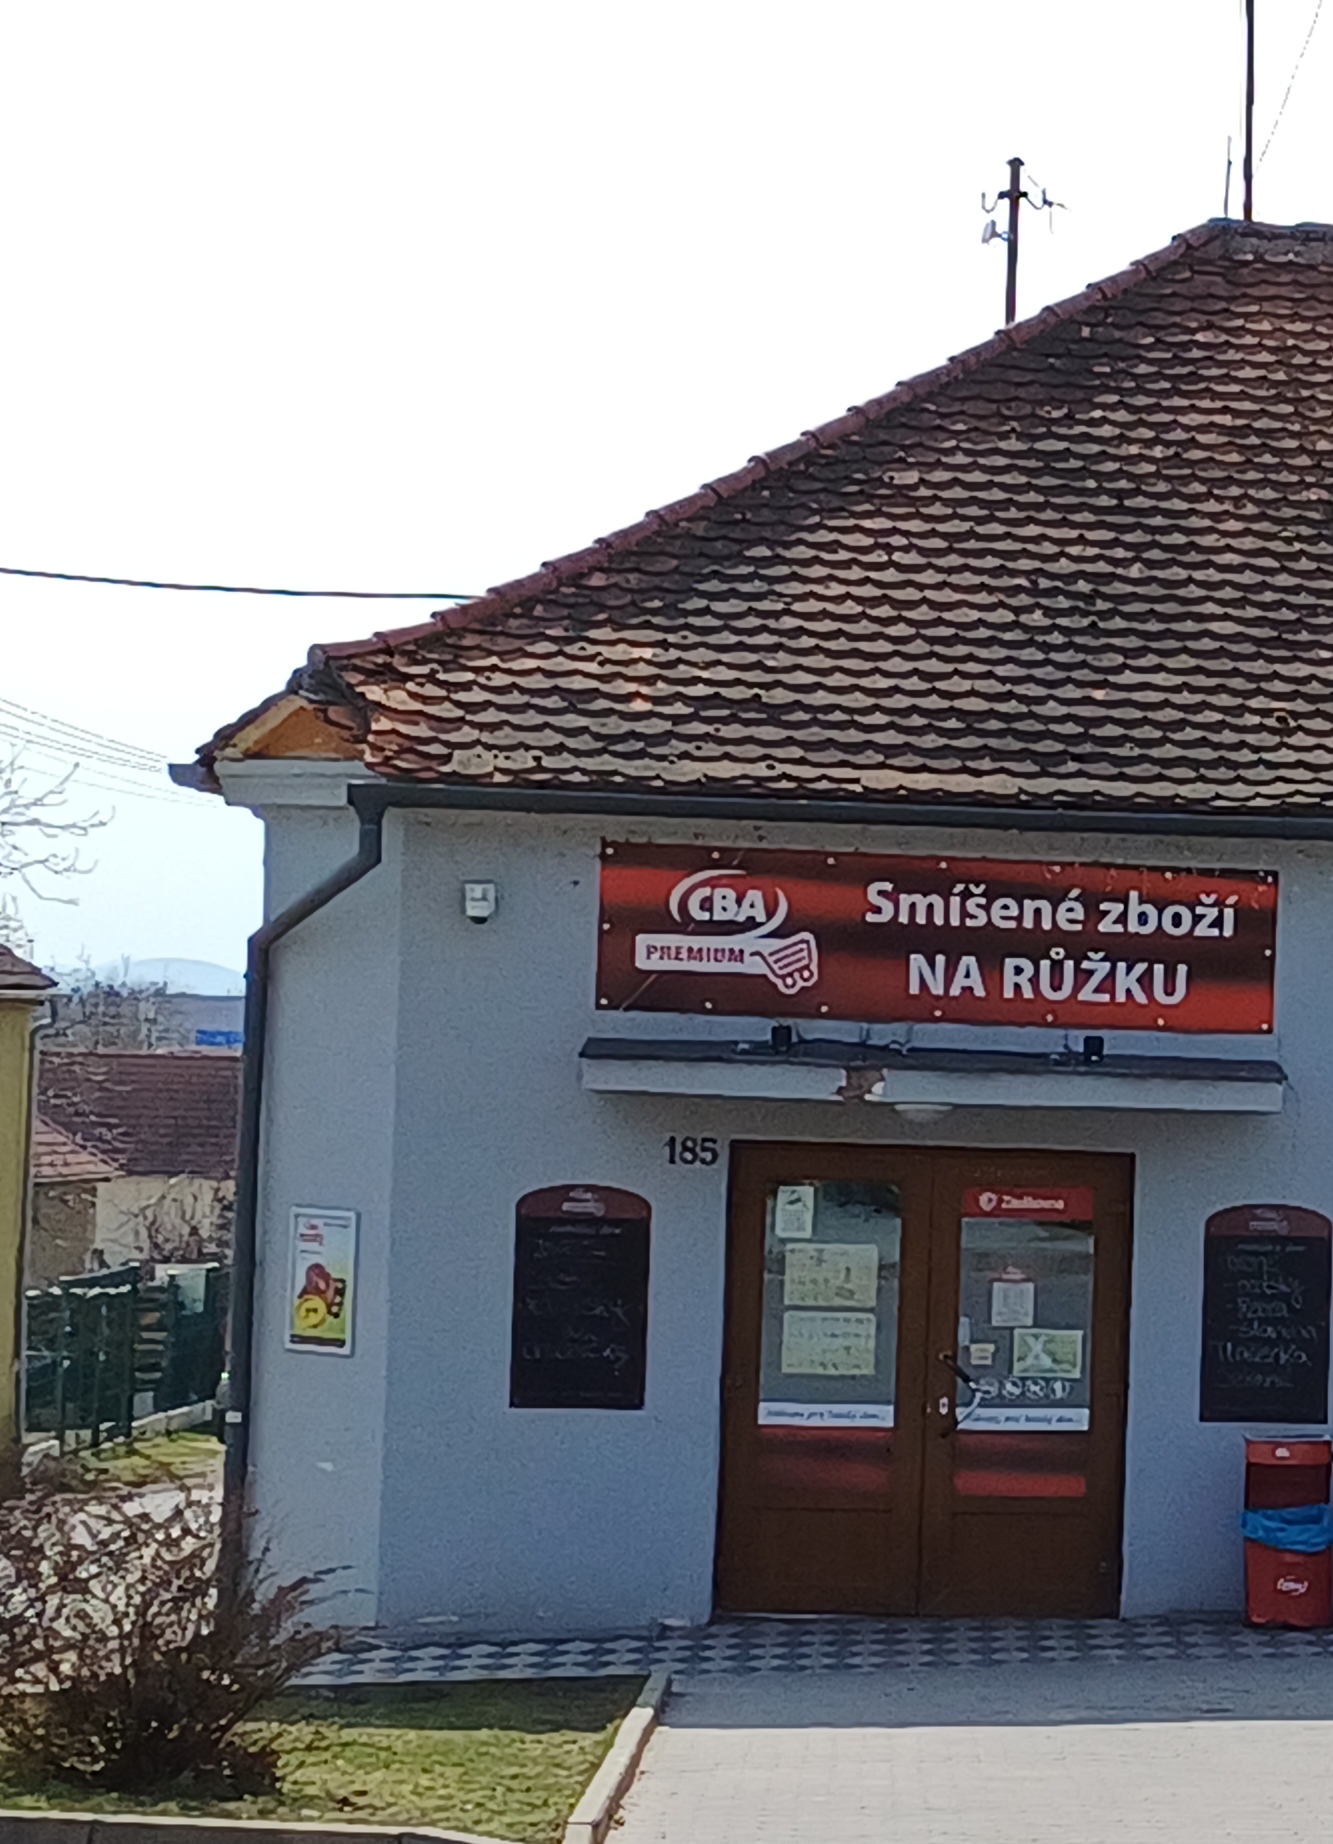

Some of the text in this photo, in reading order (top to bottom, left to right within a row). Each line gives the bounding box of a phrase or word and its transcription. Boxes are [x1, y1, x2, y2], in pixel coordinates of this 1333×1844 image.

[687, 886, 767, 923] CBA
[864, 881, 1240, 938] Smíšené zboží
[645, 944, 745, 964] PREMIUM
[908, 947, 1189, 1005] NA RŮŽKU
[662, 1135, 720, 1166] 185
